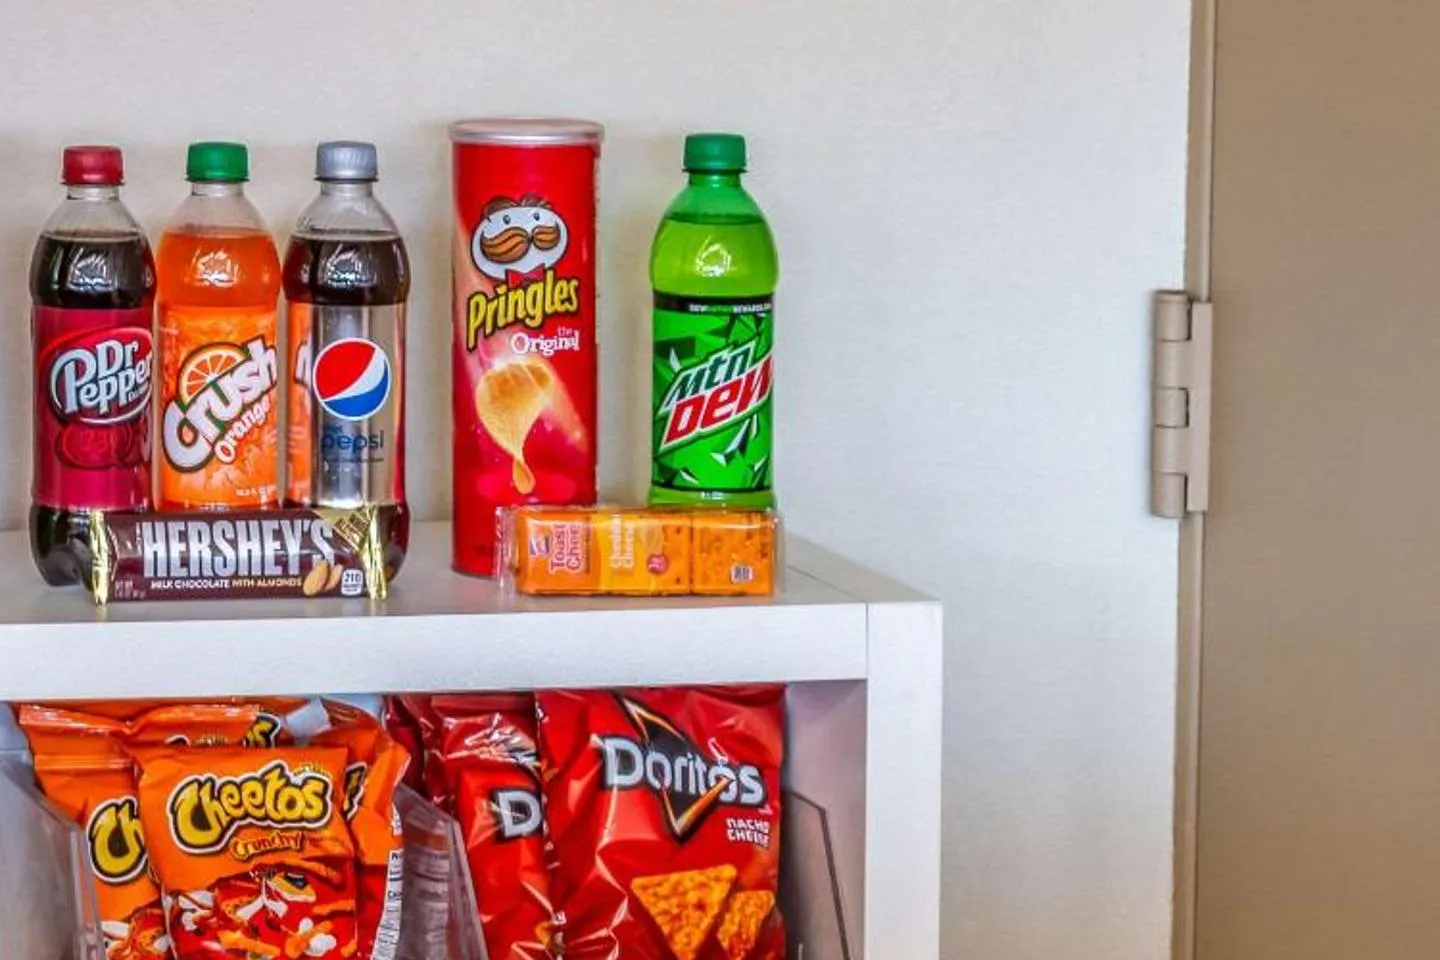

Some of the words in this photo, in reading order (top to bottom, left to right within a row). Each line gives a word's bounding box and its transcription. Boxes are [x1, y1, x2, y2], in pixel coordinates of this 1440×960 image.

[464, 270, 579, 352] Pringles
[95, 339, 139, 380] Dr
[510, 331, 580, 356] Original
[164, 339, 277, 468] Crush
[213, 395, 272, 464] Orange
[322, 429, 384, 454] pepsi
[141, 518, 336, 578] HERSHEY'S
[151, 579, 173, 589] MILK
[175, 578, 230, 589] CHOCOLATE
[232, 578, 255, 588] WITH
[257, 577, 302, 587] ALMONDS
[602, 737, 766, 806] Doritos
[169, 762, 329, 851] Cheetos
[726, 818, 770, 834] NACHO
[230, 831, 304, 861] Crunchy
